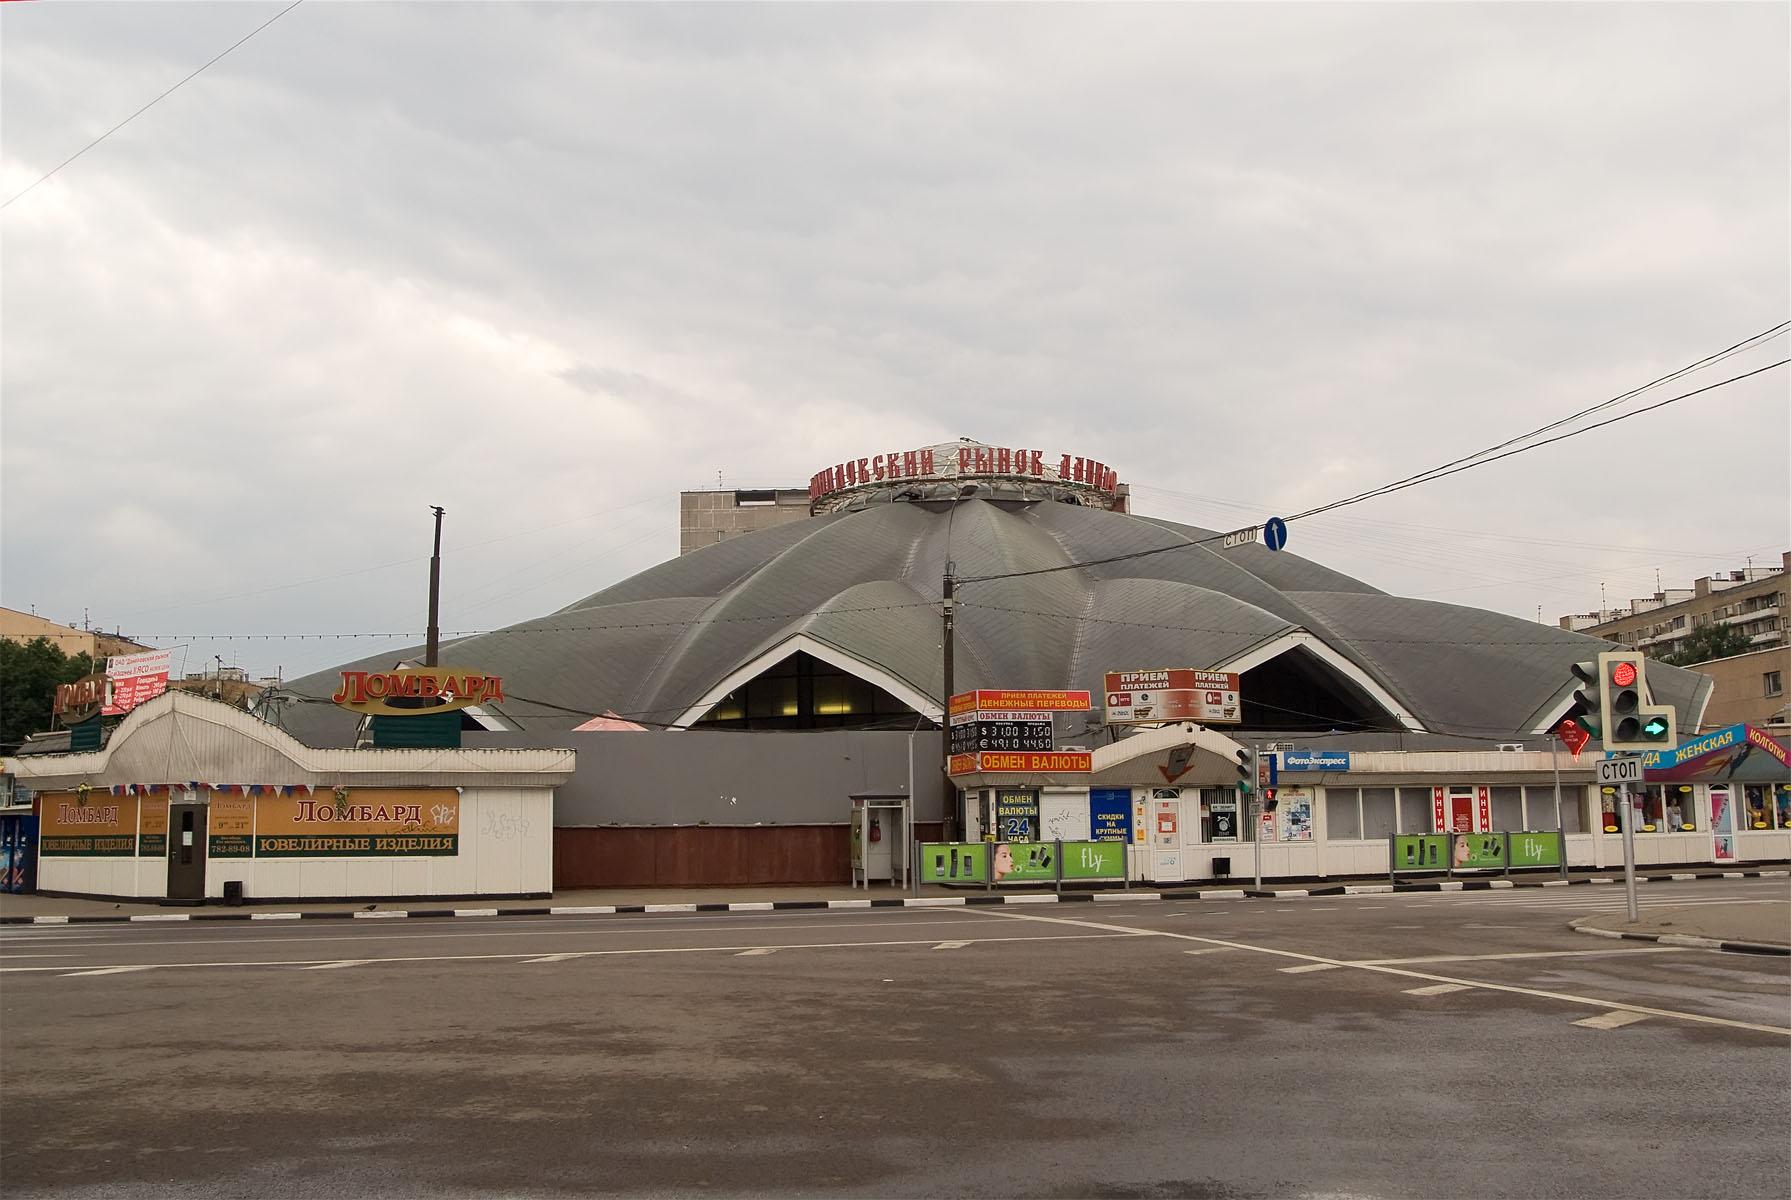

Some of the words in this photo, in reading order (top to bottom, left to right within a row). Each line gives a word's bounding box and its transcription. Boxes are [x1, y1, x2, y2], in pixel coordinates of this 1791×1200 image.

[959, 447, 1044, 475] РЫНОК
[1225, 529, 1254, 546] СТОП
[1121, 672, 1169, 682] ПРИЕМ
[1195, 672, 1228, 681] ПРИЕМ
[1121, 681, 1169, 690] ПЛАТЕЖЕЙ
[980, 700, 1034, 708] ДЕНЕЖНЫЕ
[1036, 700, 1088, 708] ПЕРЕВОДЫ
[979, 712, 1009, 720] ОБМЕН
[1011, 712, 1050, 720] ВАЛЮТЫ
[981, 727, 988, 736] $
[980, 739, 989, 749] €
[1676, 731, 1733, 762] ЖЕНСКАЯ
[1750, 729, 1786, 762] КОЛГОТКИ
[983, 756, 1025, 769] ОБМЕН
[1032, 756, 1089, 768] ВАЛЮТЫ
[1287, 757, 1346, 766] ФотоЭкспресс
[1602, 762, 1637, 780] СТОП
[999, 807, 1037, 815] ВАЛЮТЫ
[1008, 818, 1030, 835] 24
[260, 838, 371, 851] ЮВЕЛИРНЫЕ
[375, 837, 453, 853] ИЗДЕЛИЯ
[1525, 839, 1549, 861] fly
[1082, 848, 1112, 872] fly
